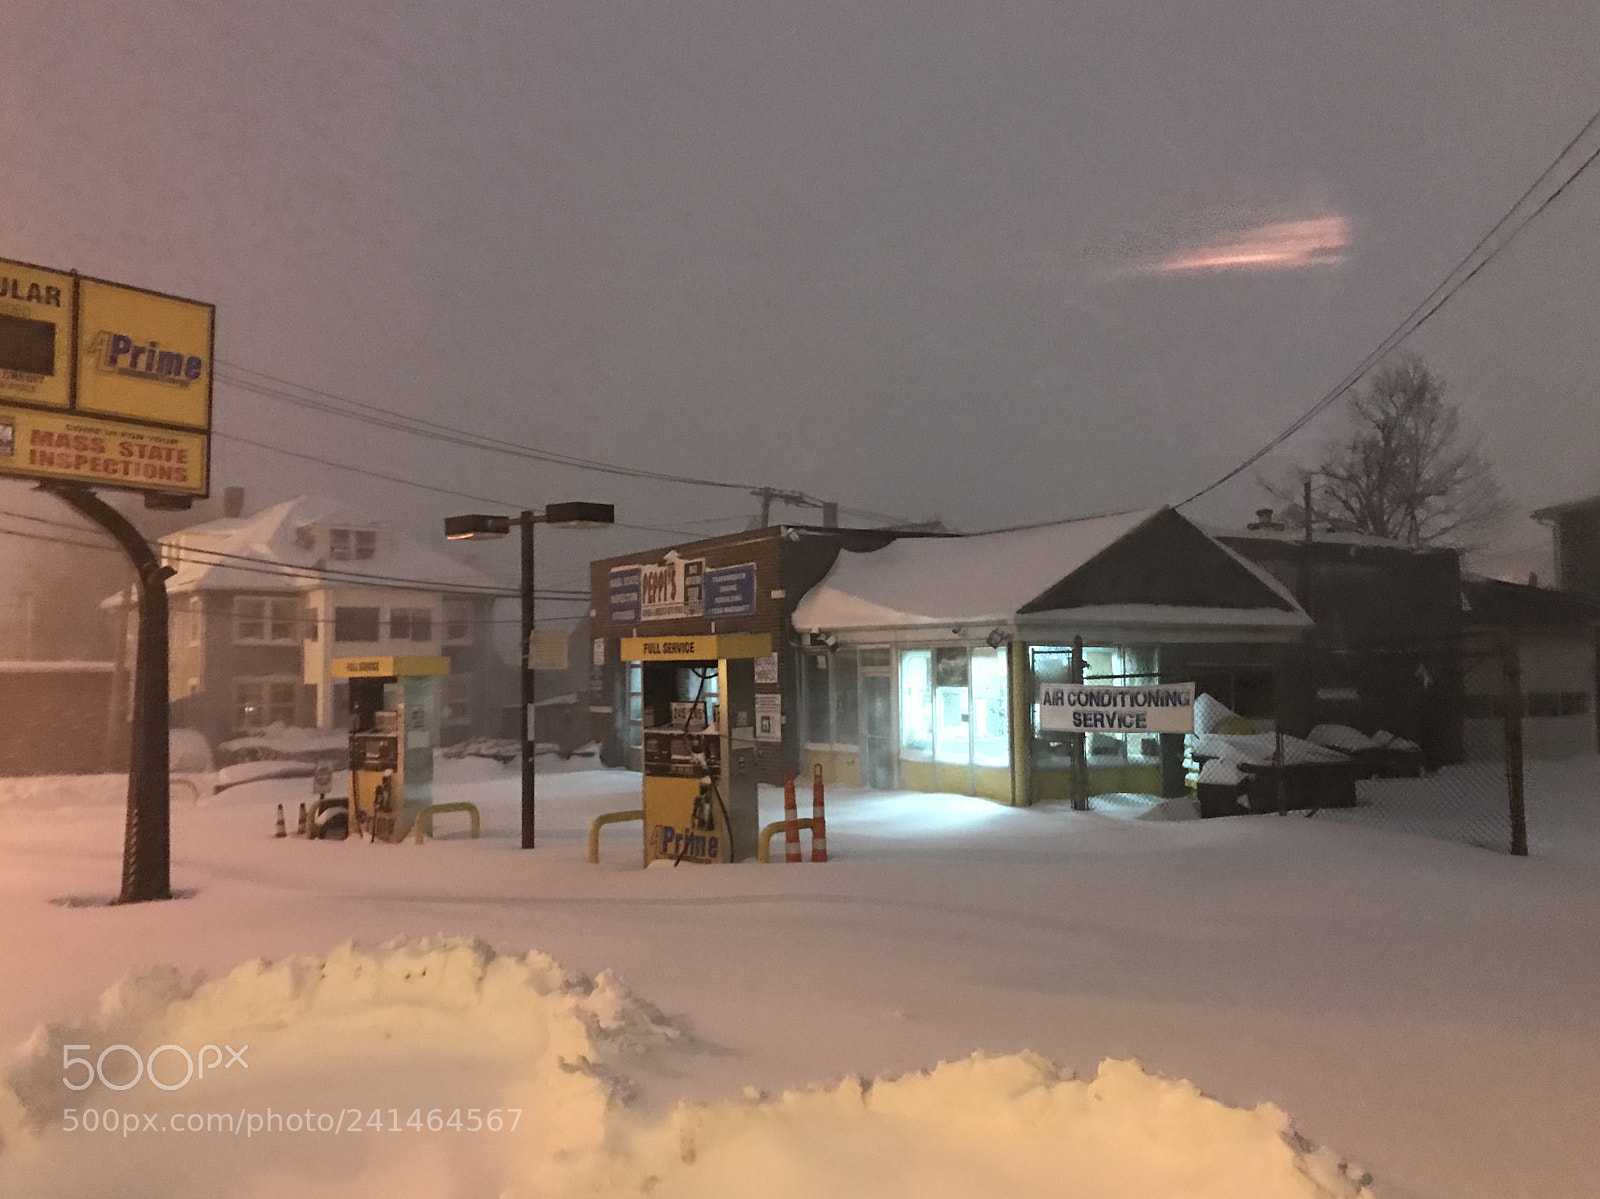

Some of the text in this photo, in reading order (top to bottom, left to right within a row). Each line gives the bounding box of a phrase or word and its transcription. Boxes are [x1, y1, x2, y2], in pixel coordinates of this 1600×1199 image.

[109, 333, 202, 380] Prime
[30, 429, 188, 464] MASS STATE
[29, 448, 188, 482] INSPECTIONS
[643, 641, 695, 654] FULL SERVICE
[1043, 688, 1191, 708] AIR CONDITIONING
[1072, 711, 1148, 729] SERVICE
